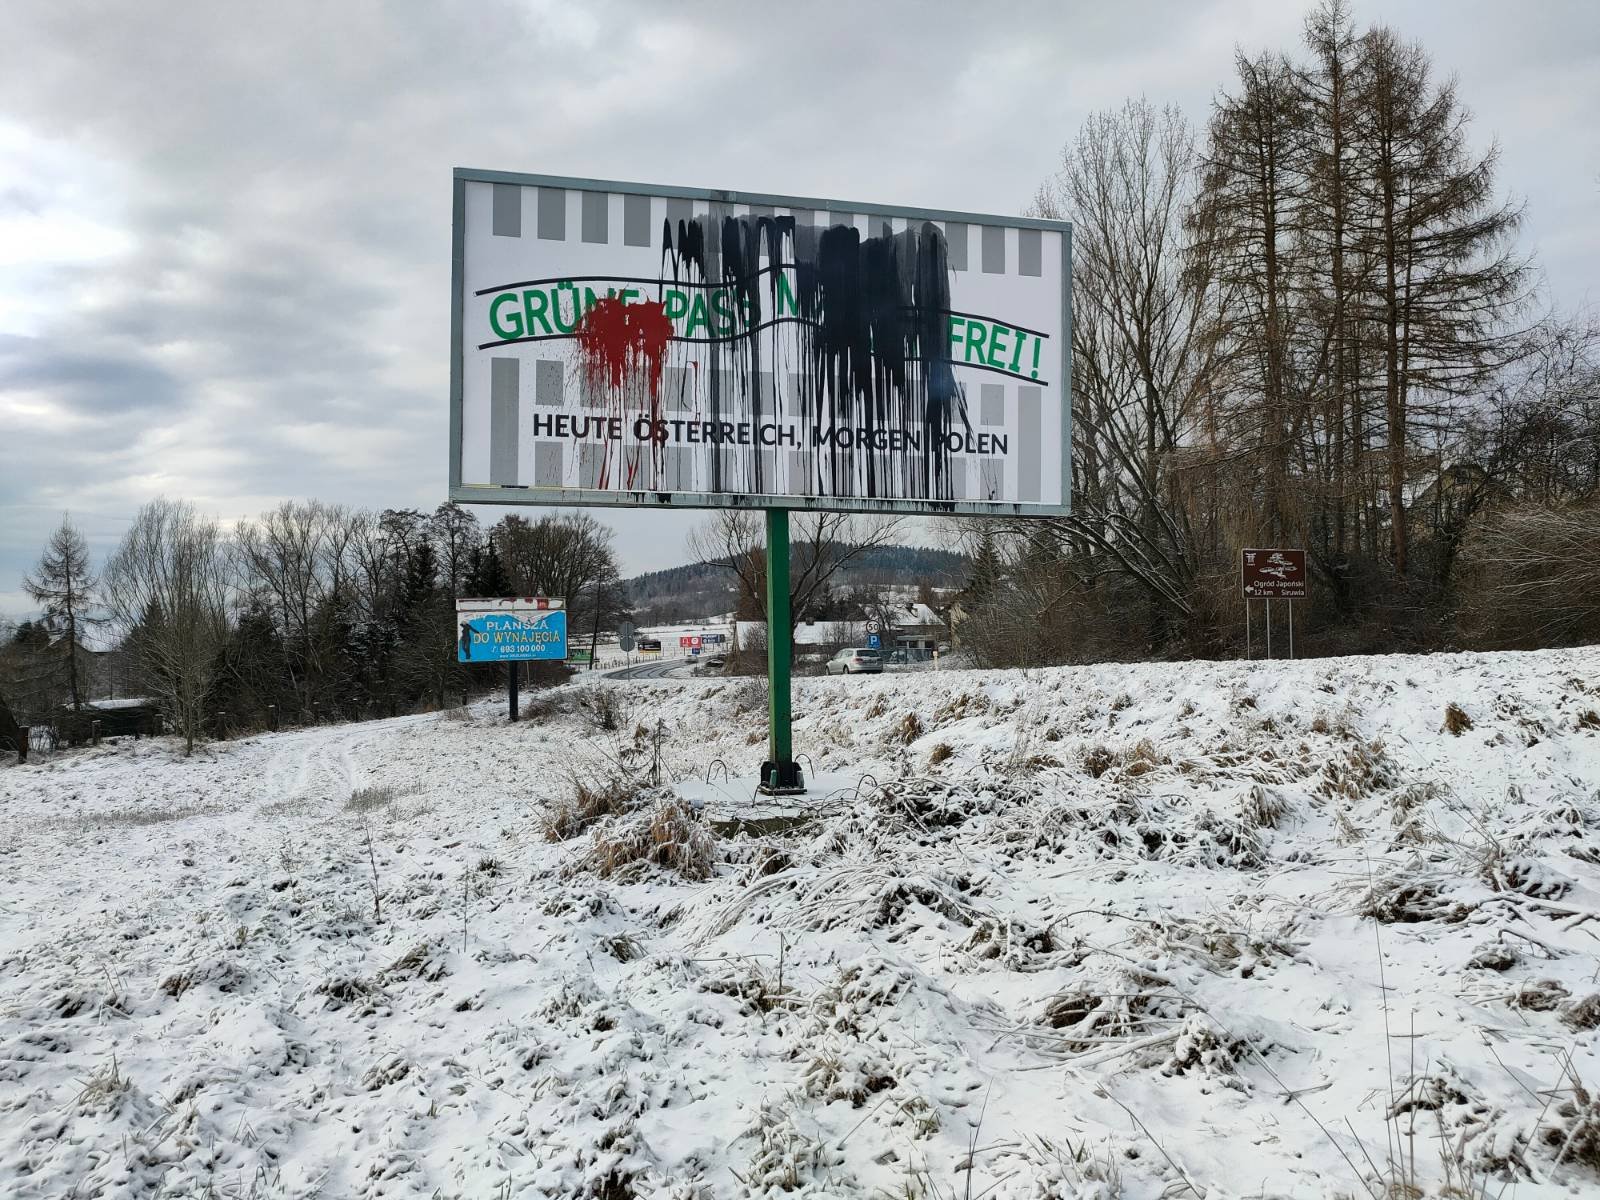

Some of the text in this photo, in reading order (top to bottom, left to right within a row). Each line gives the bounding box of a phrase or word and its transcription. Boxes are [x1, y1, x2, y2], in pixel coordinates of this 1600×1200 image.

[489, 280, 640, 340] GRÜ
[665, 287, 753, 338] PAS
[948, 316, 1041, 379] FREI!
[533, 413, 623, 440] HEUTE
[633, 413, 802, 450] ÖSTERREICH,
[812, 425, 921, 452] MORGEN
[1254, 579, 1304, 588] Ogród Japoński
[486, 620, 548, 631] PLANSZA
[868, 623, 879, 631] 50
[473, 630, 561, 645] DO WYNAJĘCIA
[870, 635, 878, 645] P
[517, 644, 530, 653] 100
